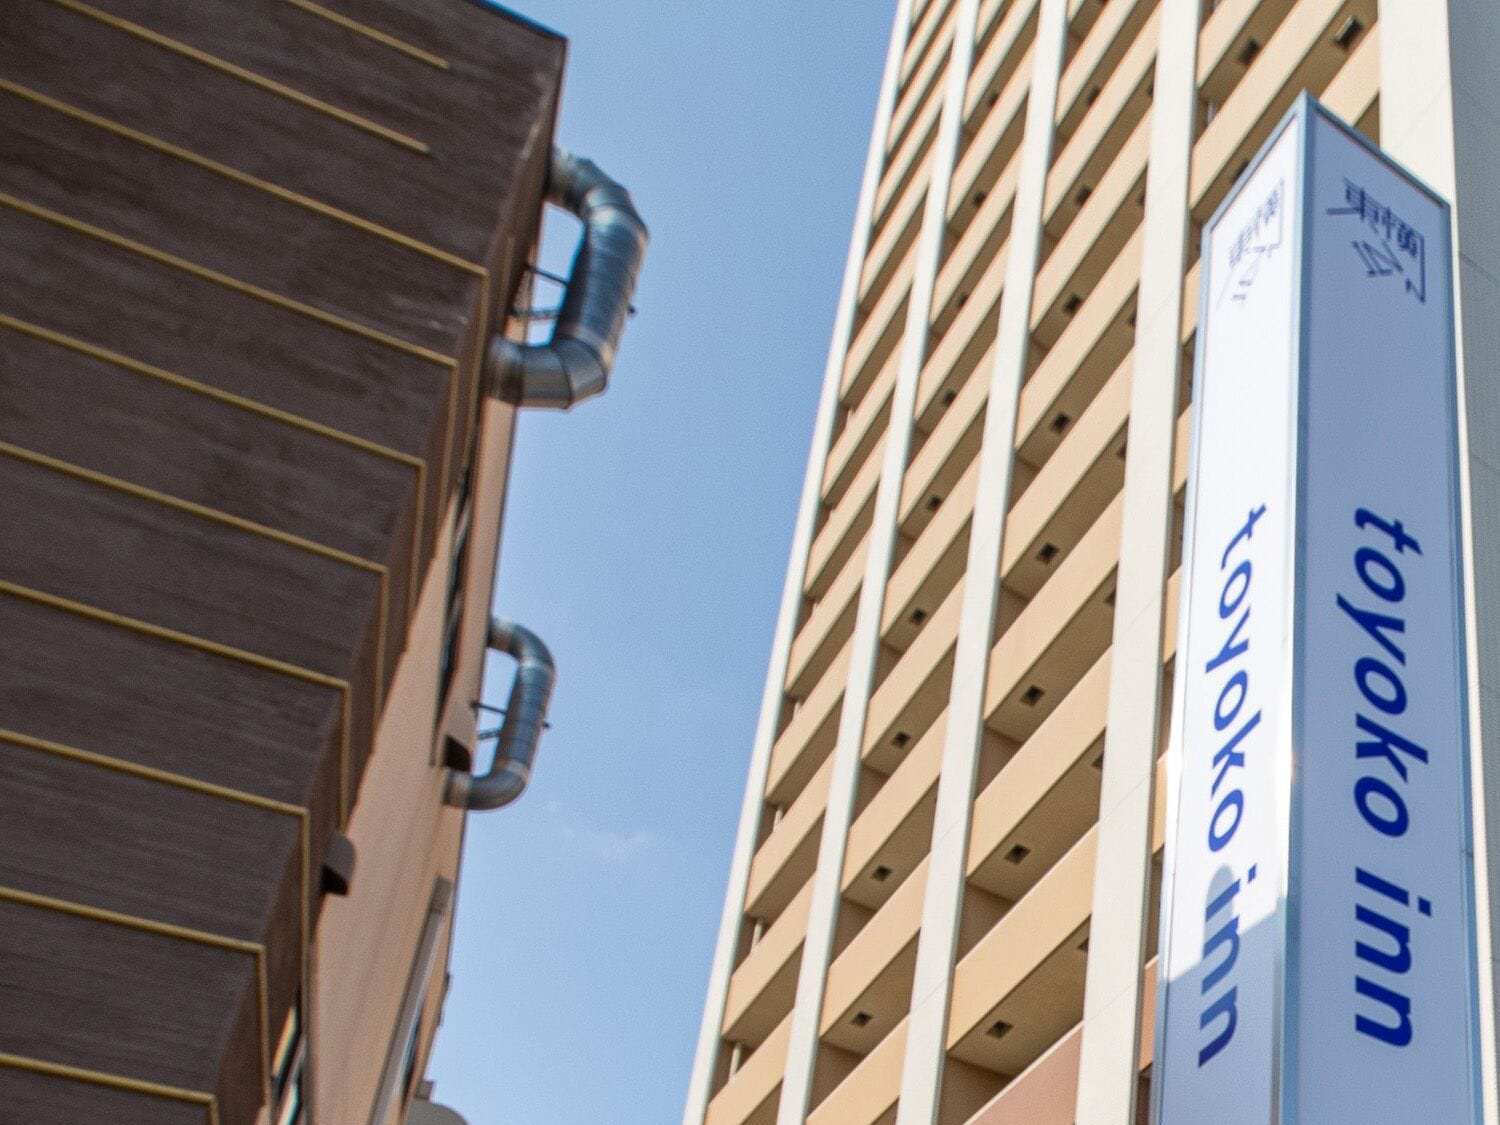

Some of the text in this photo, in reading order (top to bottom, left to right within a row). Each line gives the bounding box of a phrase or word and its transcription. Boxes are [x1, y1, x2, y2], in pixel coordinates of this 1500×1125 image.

[1198, 503, 1267, 1069] toyoko inn
[1336, 506, 1432, 1048] toyoko inn
